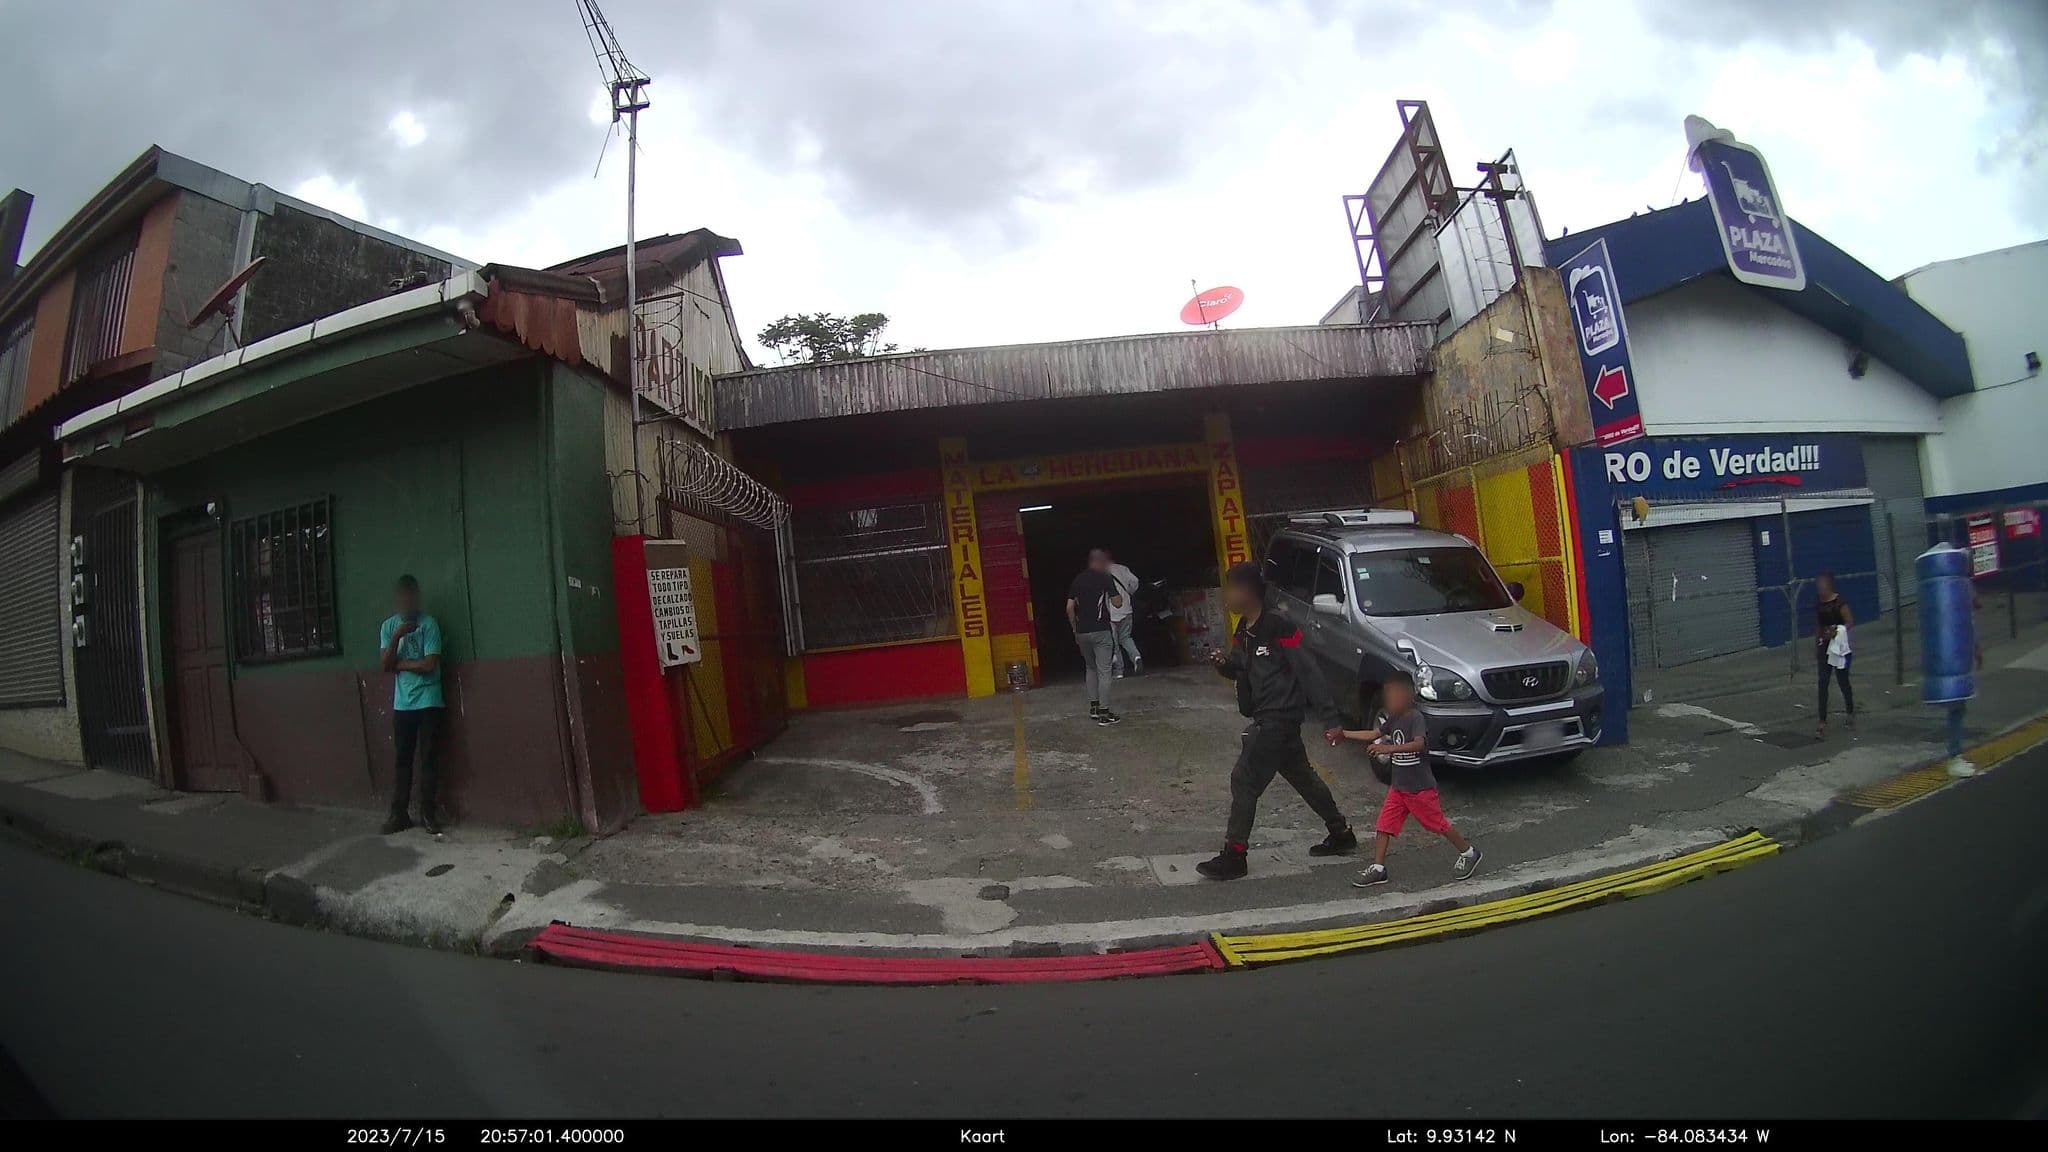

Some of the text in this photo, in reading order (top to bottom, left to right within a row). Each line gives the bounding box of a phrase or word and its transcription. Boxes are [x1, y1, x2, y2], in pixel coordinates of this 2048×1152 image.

[1729, 225, 1784, 255] PLAZA
[1749, 250, 1793, 270] Mercados
[1199, 296, 1229, 308] Claro
[1585, 316, 1609, 340] PLAZA
[1663, 450, 1701, 479] de
[1709, 445, 1820, 476] Verdad!!!
[980, 465, 1015, 485] LA
[1217, 441, 1249, 577] ZAPATER
[945, 453, 985, 639] MATERIALES
[651, 569, 688, 581] SE REPARA
[652, 581, 689, 593] TODO TIPO
[652, 592, 693, 605] DE CALZADO
[654, 605, 685, 617] CAMBIOS
[659, 617, 692, 630] TAPILLAS
[660, 629, 694, 641] Y SUELAS
